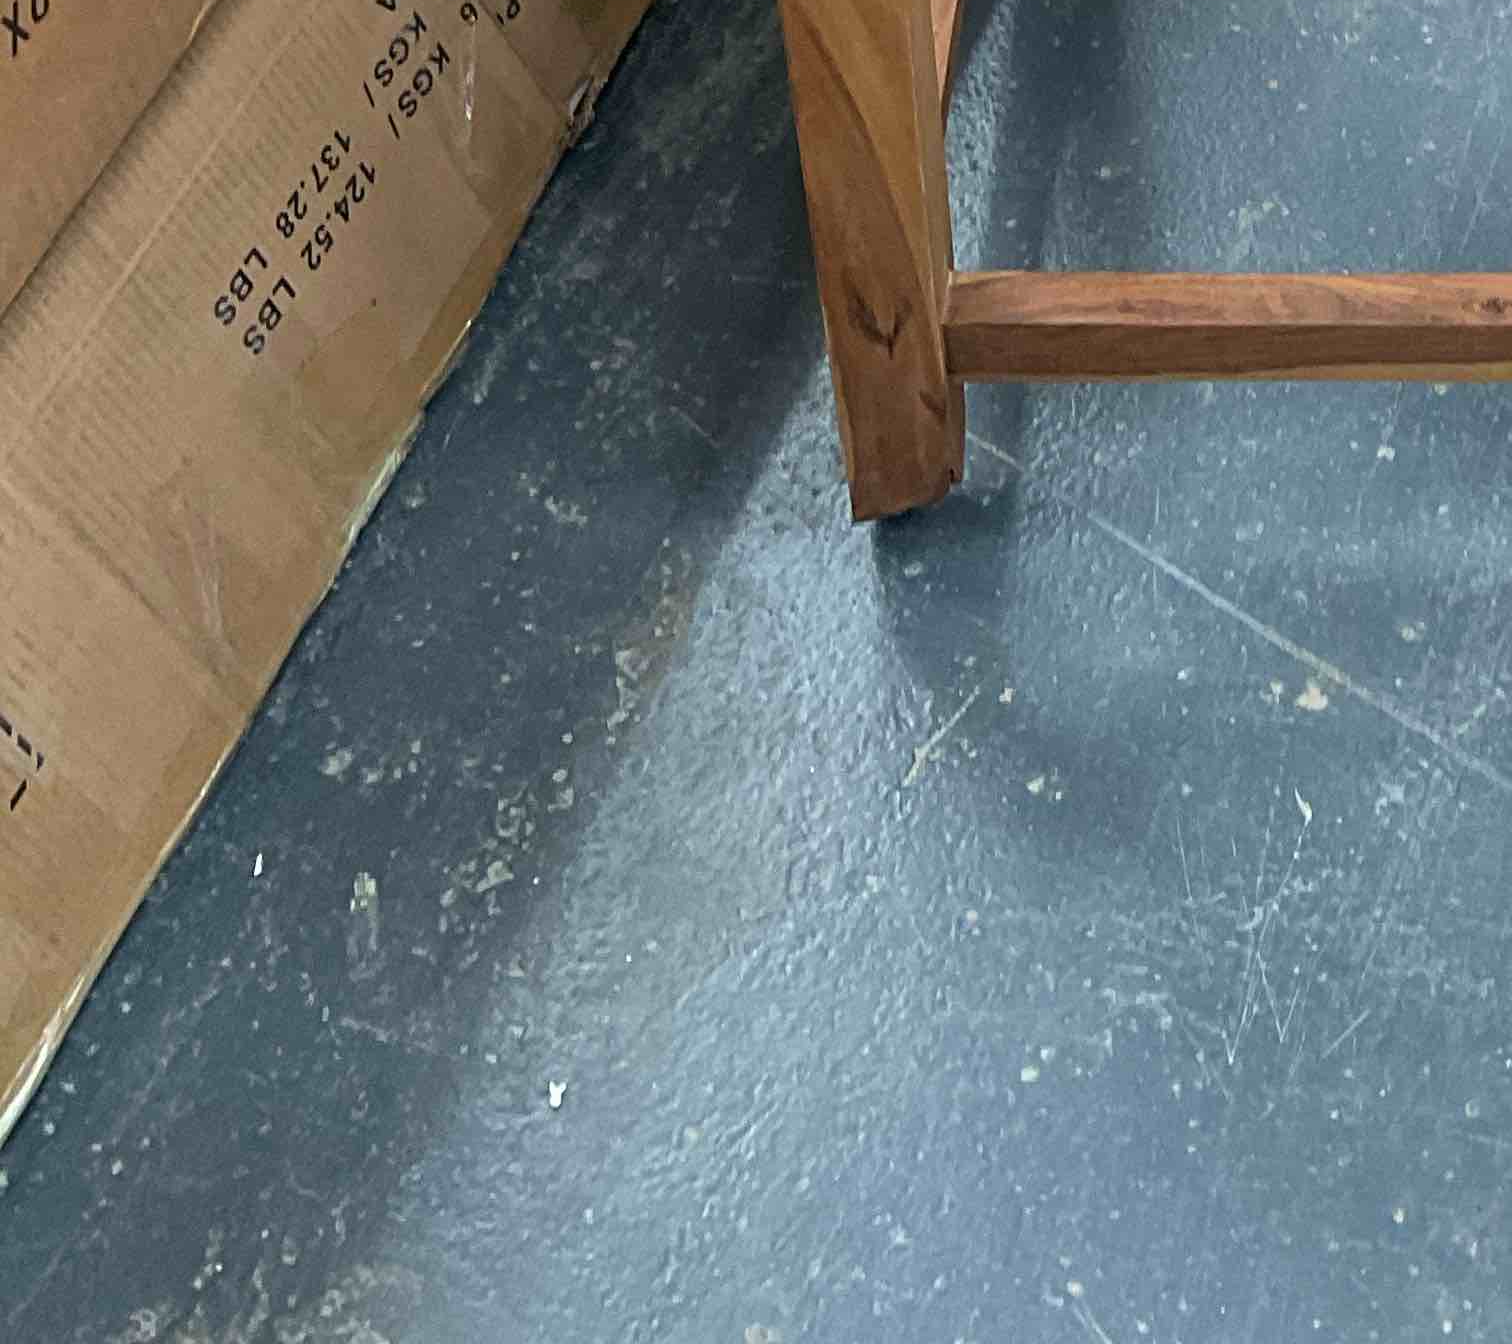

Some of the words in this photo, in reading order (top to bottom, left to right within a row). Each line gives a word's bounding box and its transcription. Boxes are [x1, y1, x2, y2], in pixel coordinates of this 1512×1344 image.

[275, 129, 351, 240] 137.28
[300, 161, 376, 271] 124.52
[213, 247, 269, 326] LBS
[243, 275, 296, 355] LBS
